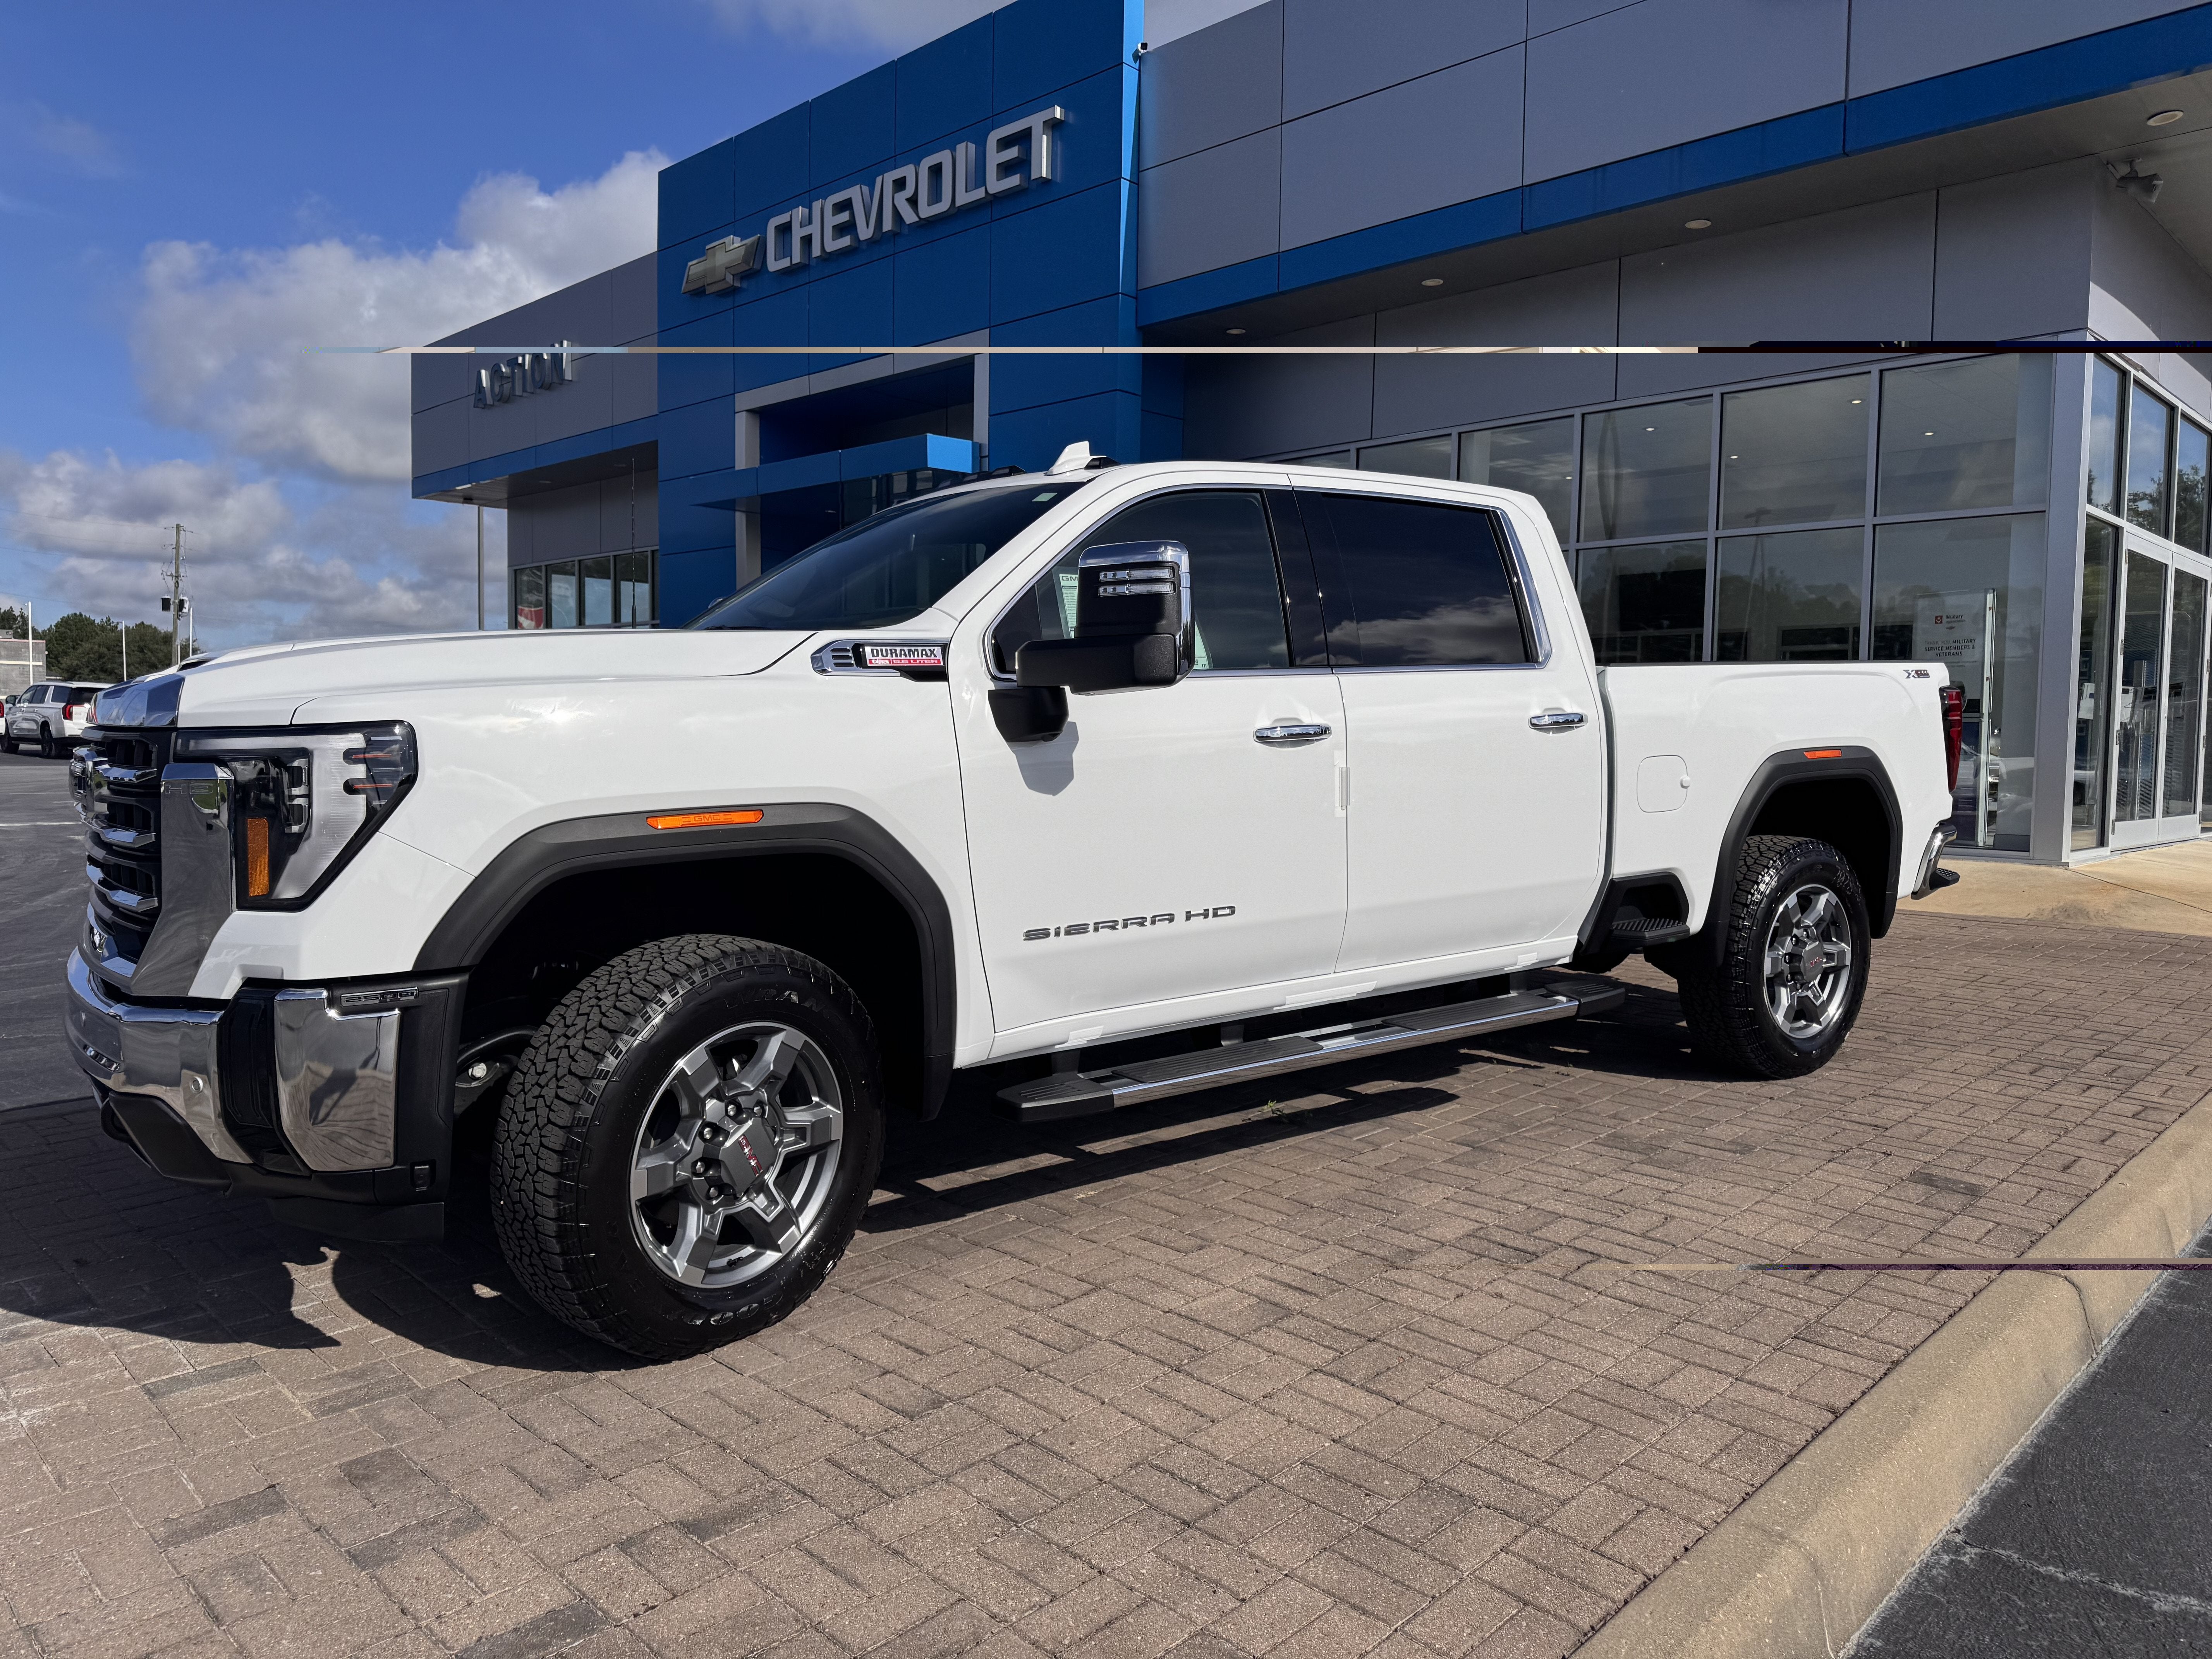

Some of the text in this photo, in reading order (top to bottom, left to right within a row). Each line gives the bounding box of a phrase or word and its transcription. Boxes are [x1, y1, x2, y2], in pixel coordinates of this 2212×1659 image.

[767, 105, 1064, 272] CHEVROLET
[473, 340, 572, 408] ACTION
[871, 648, 937, 658] DURAMAX
[1023, 906, 1236, 941] SIERRA HD
